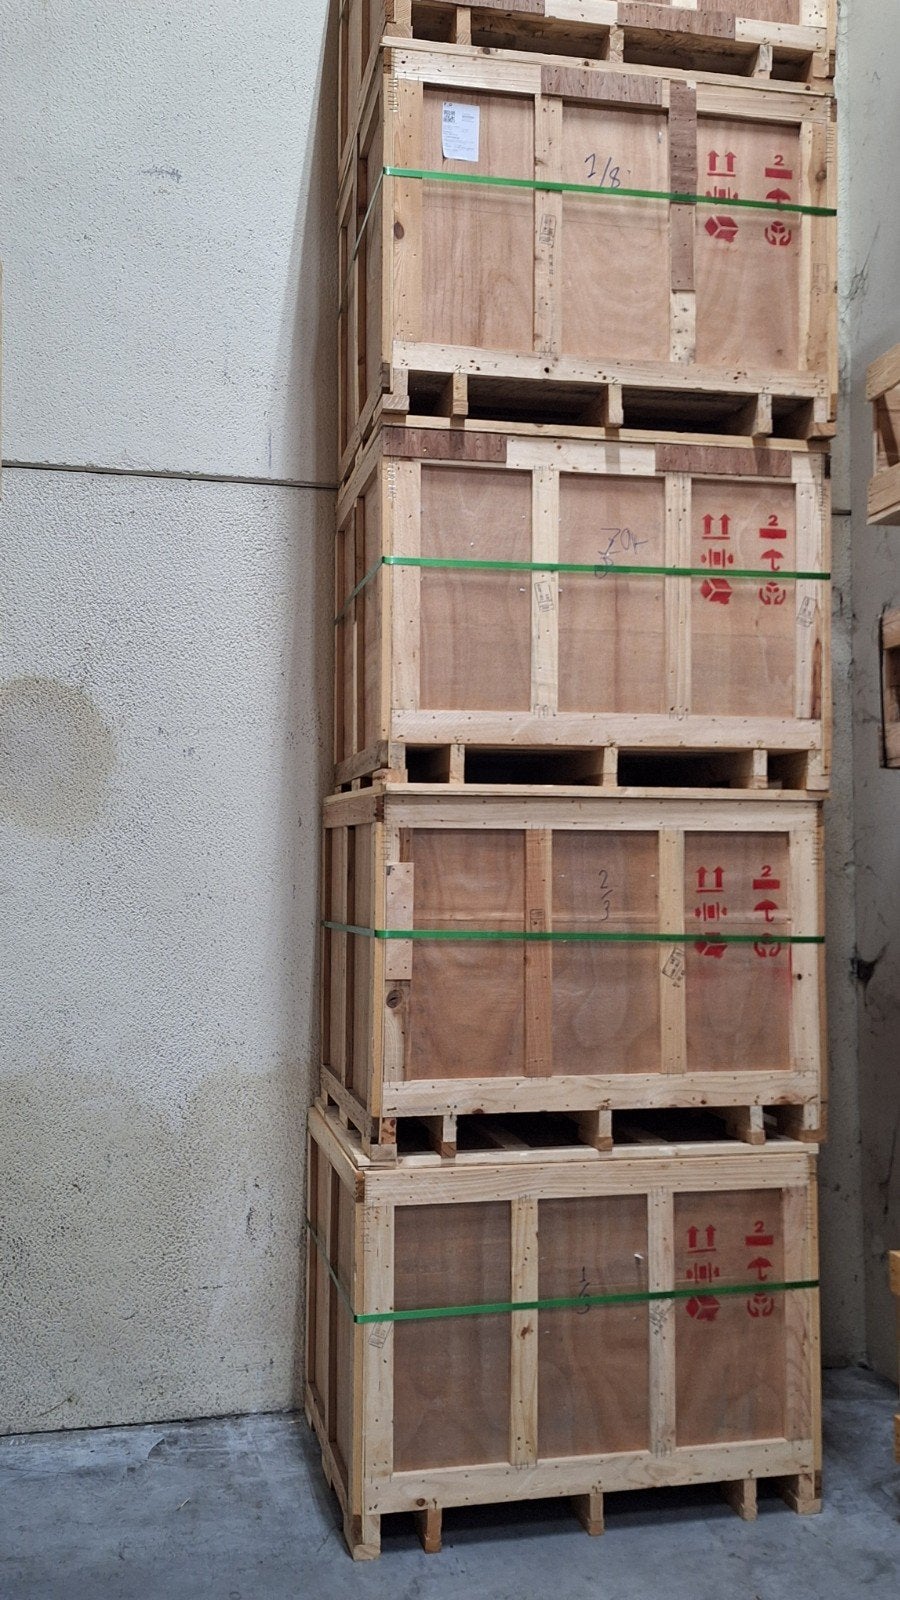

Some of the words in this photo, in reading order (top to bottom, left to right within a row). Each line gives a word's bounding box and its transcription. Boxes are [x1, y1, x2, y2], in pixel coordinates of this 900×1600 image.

[774, 154, 785, 166] 2
[768, 514, 779, 526] 2
[761, 864, 772, 877] 2
[754, 1220, 765, 1233] 2
